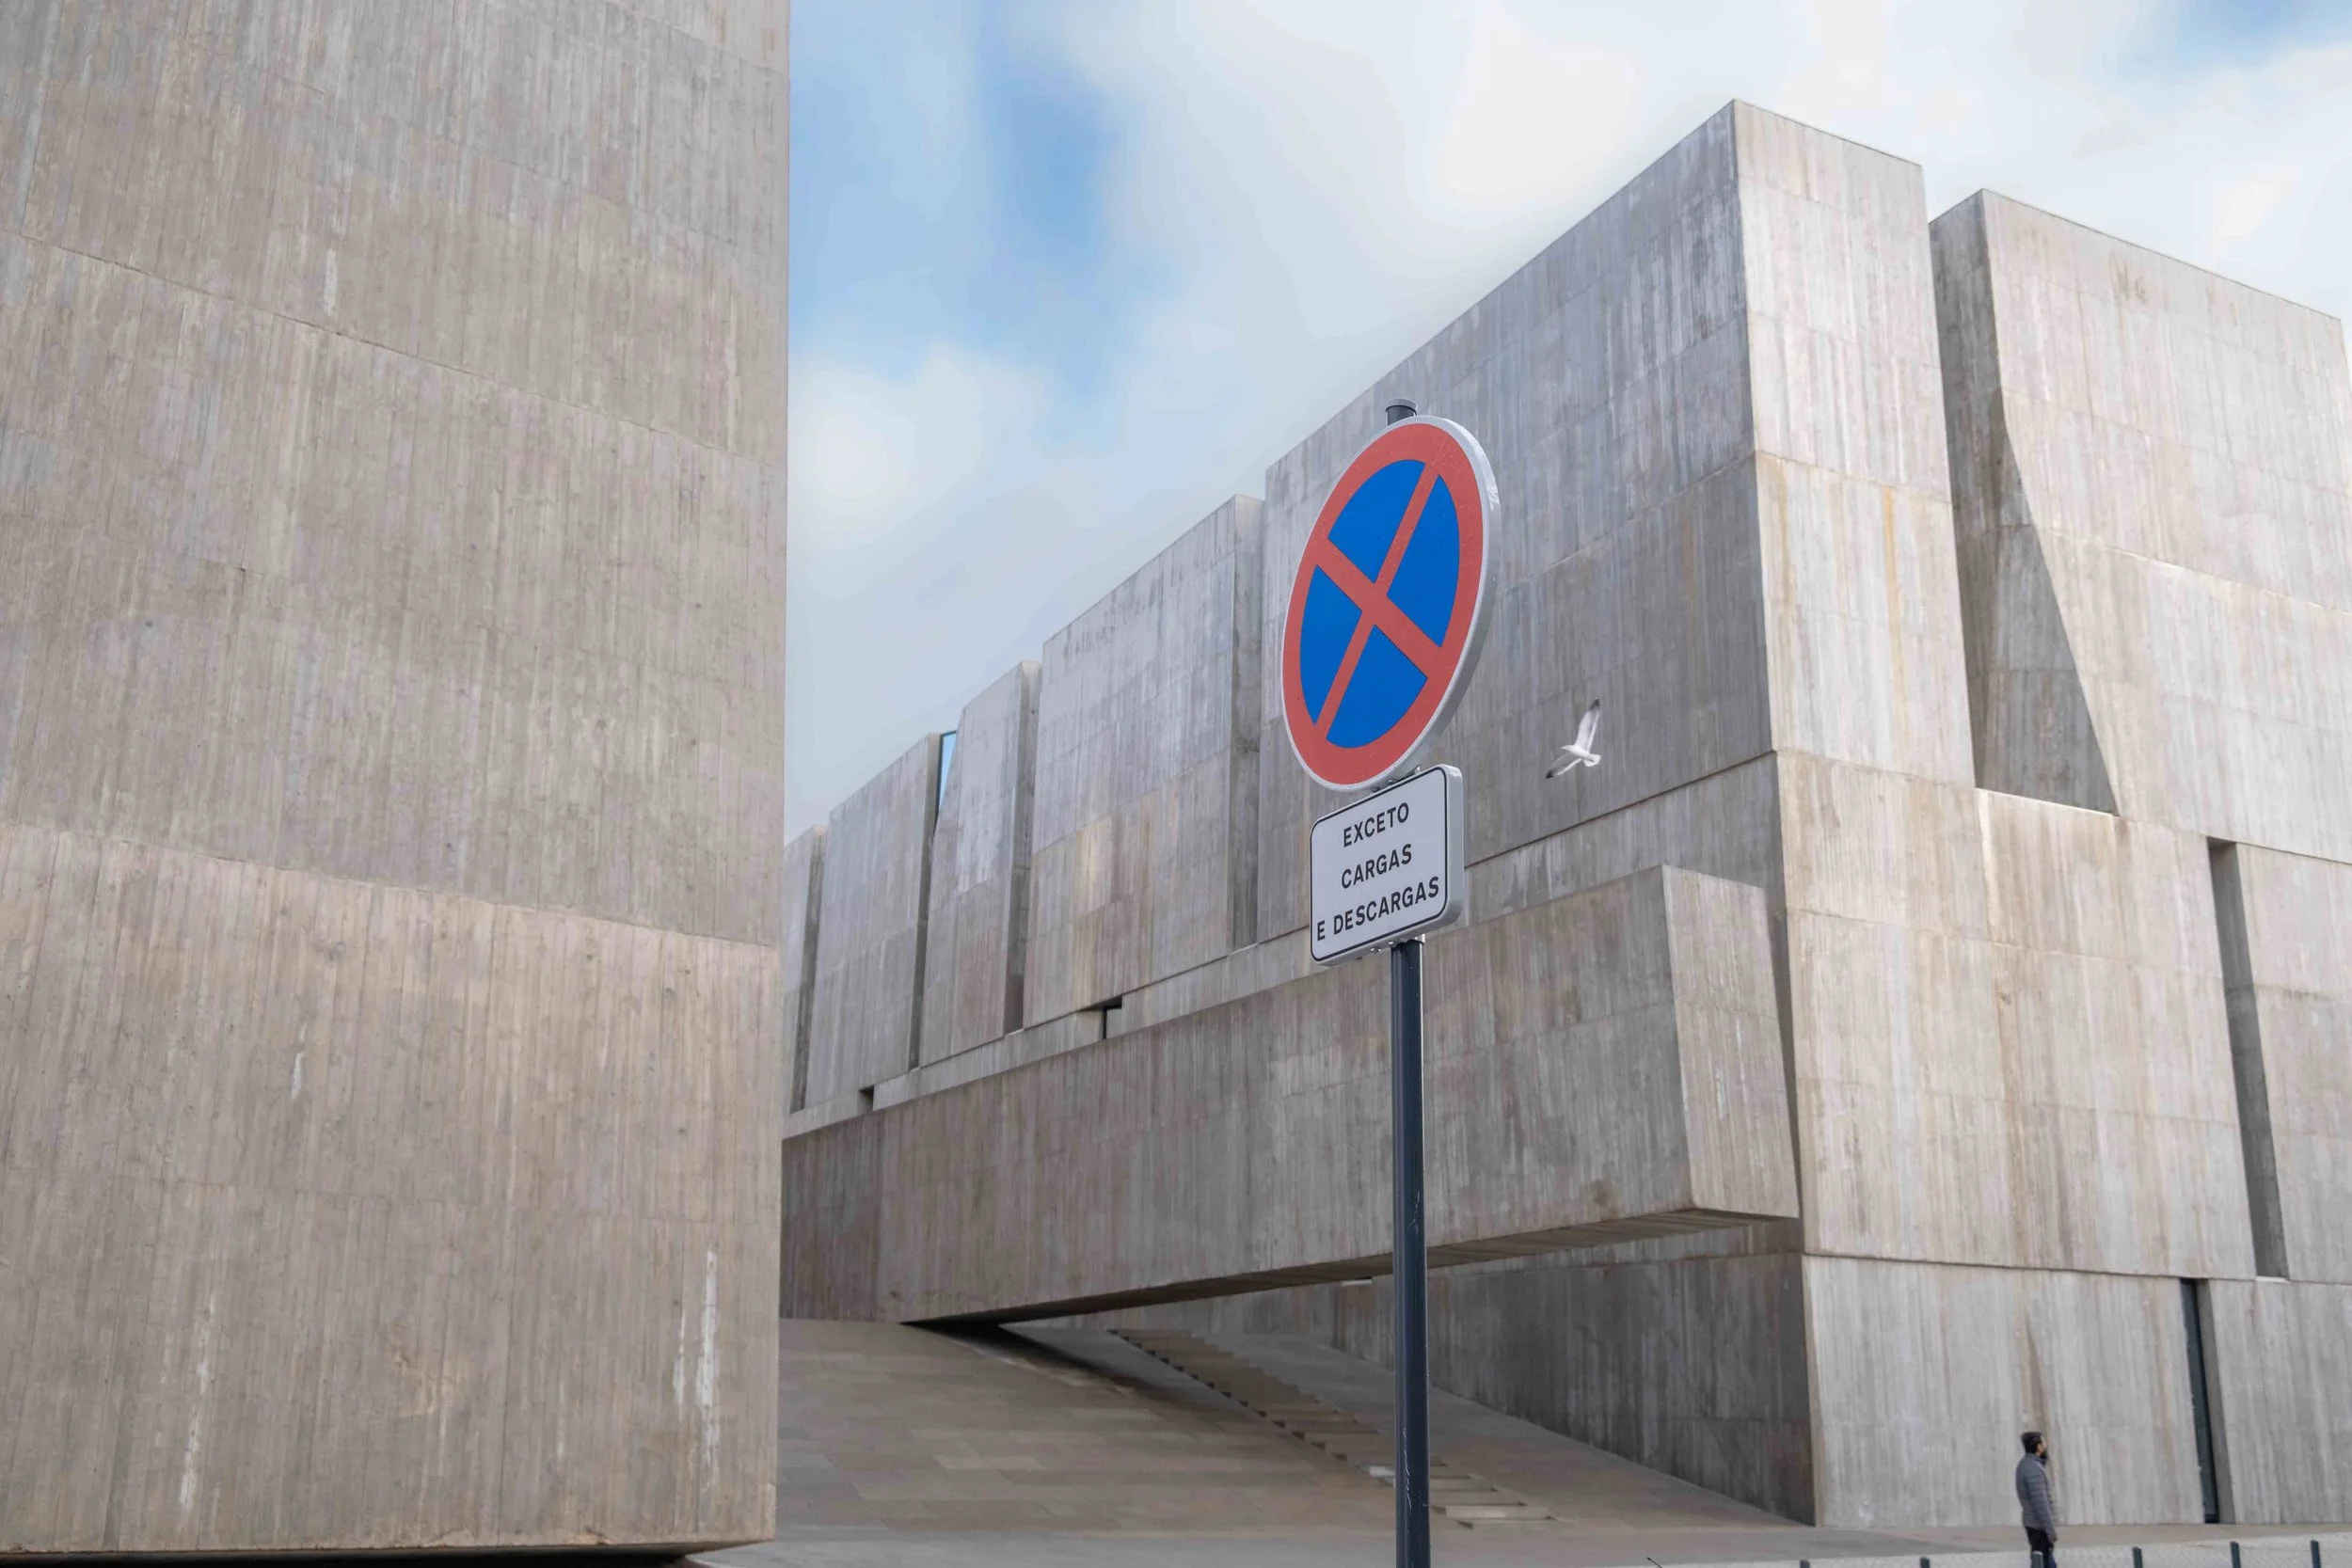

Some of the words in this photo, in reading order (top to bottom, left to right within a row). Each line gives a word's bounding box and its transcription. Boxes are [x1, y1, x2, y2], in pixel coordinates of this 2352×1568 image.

[1343, 802, 1409, 847] EXCETO
[1342, 844, 1412, 889] CARGAS
[1317, 920, 1326, 941] E
[1333, 876, 1439, 935] DESCARGAS
